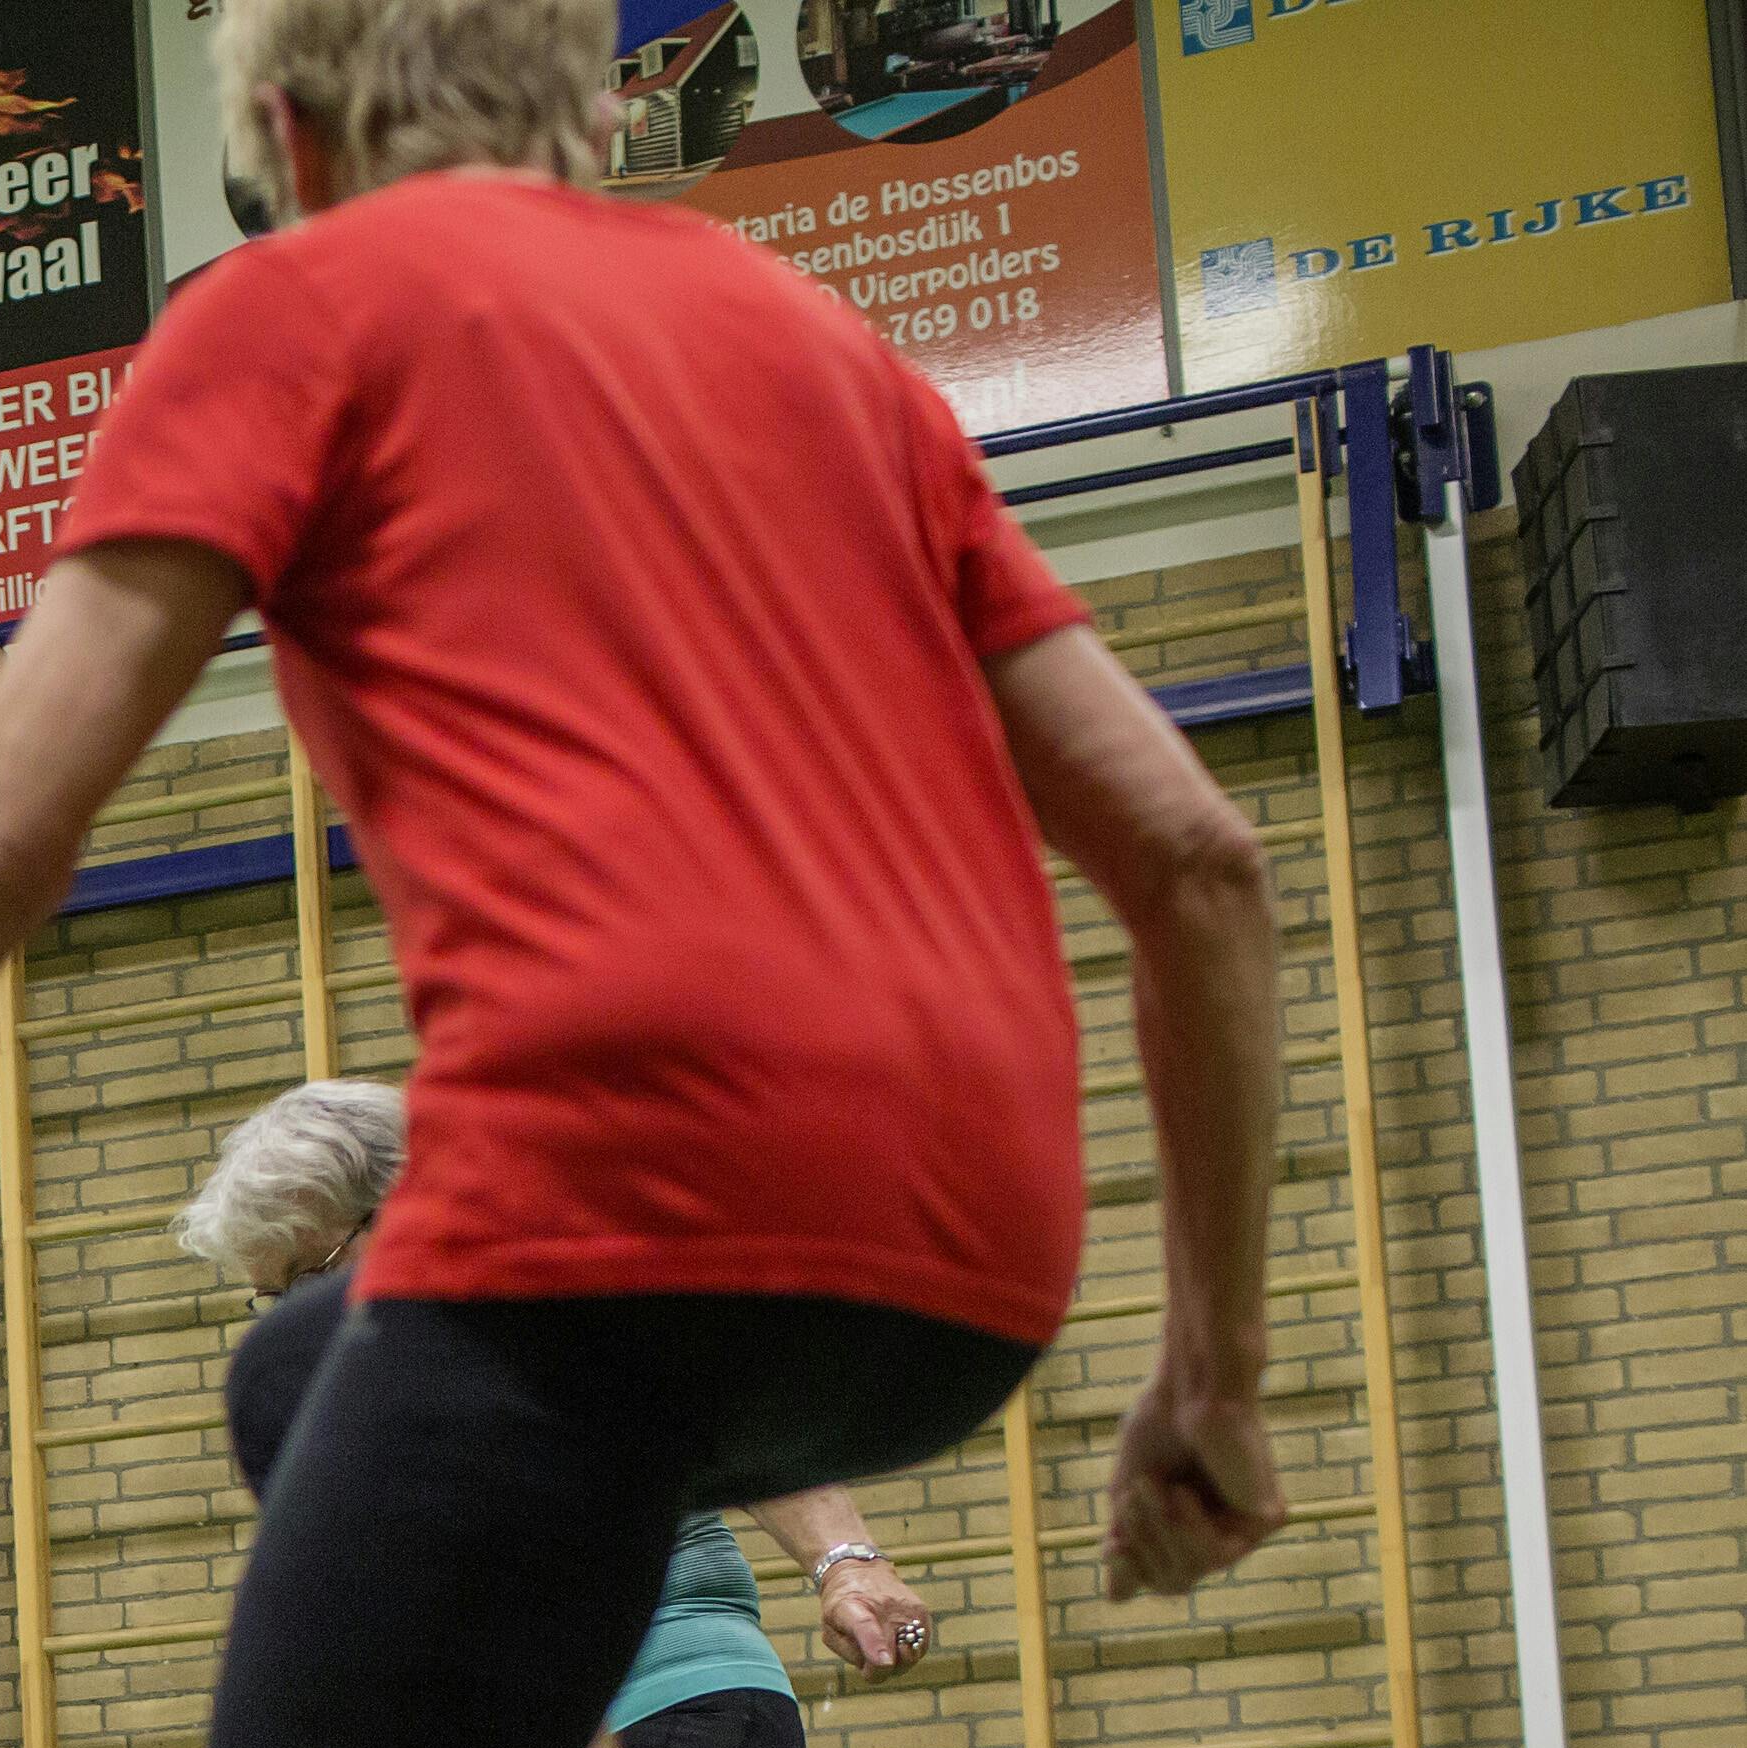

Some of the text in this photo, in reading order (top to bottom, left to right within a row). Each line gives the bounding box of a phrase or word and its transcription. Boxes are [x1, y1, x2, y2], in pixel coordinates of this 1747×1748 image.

[827, 192, 871, 226] de
[881, 148, 1081, 217] Hossenbos
[996, 202, 1012, 236] 1
[1285, 174, 1694, 283] DE RIJKE
[849, 242, 1061, 311] Vierpolders
[968, 286, 1042, 331] 018
